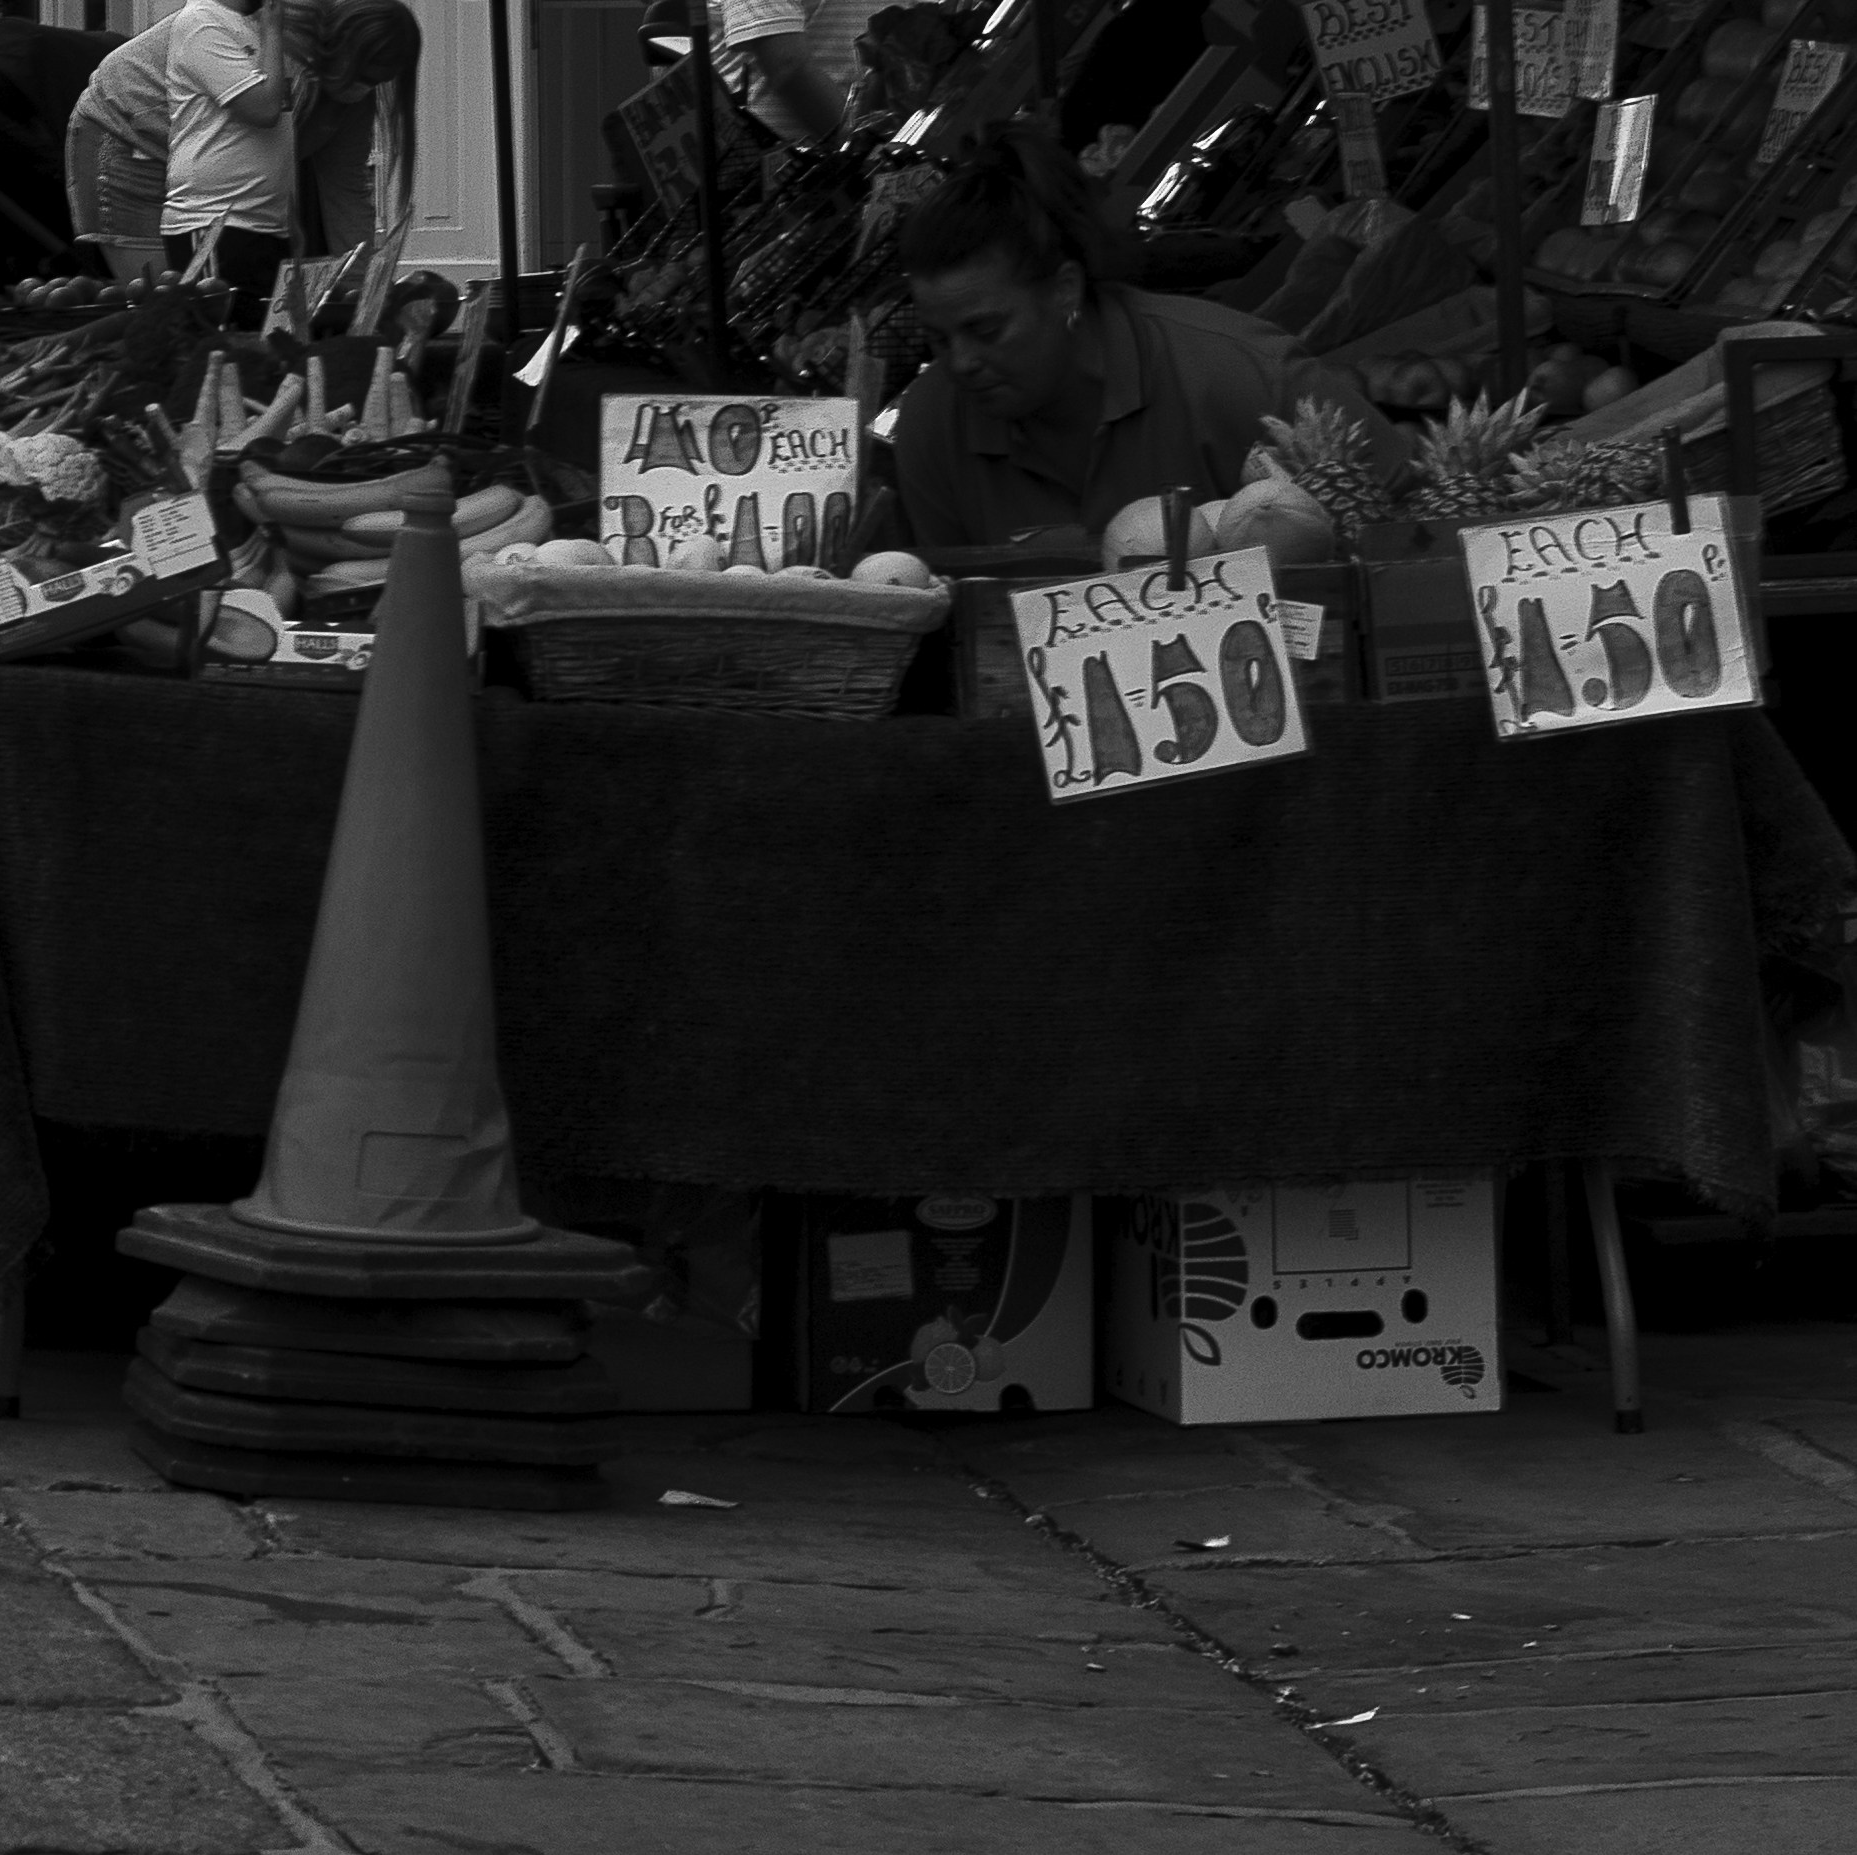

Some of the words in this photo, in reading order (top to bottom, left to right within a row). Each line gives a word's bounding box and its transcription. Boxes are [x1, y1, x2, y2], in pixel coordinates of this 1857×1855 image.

[766, 427, 853, 466] EACH
[658, 505, 704, 534] FOR
[1498, 512, 1651, 577] EACH
[1042, 559, 1243, 648] EACH
[1355, 1346, 1464, 1371] KROMCO
